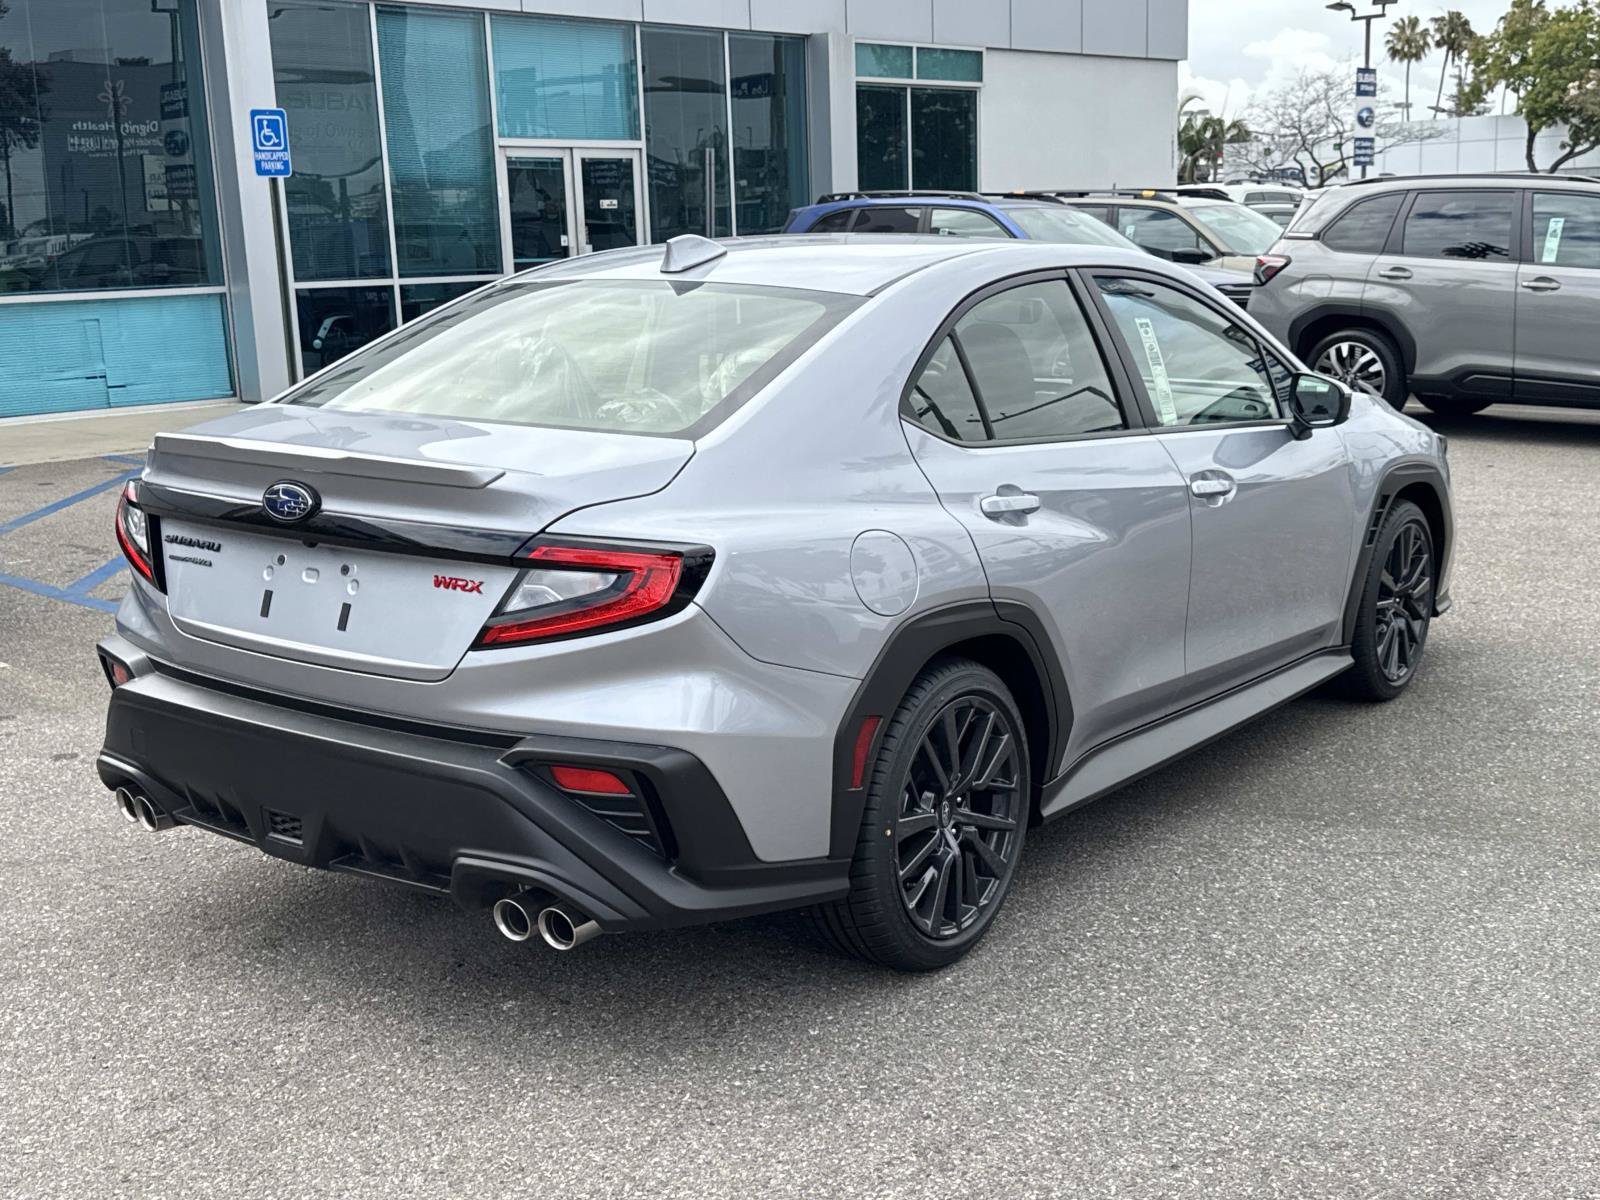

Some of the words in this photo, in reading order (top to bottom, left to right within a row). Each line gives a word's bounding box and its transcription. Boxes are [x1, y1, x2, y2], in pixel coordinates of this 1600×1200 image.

[254, 151, 289, 161] HANDICAPPED
[261, 160, 285, 170] PARKING
[164, 534, 222, 553] SUBARU
[433, 574, 484, 595] WRX
